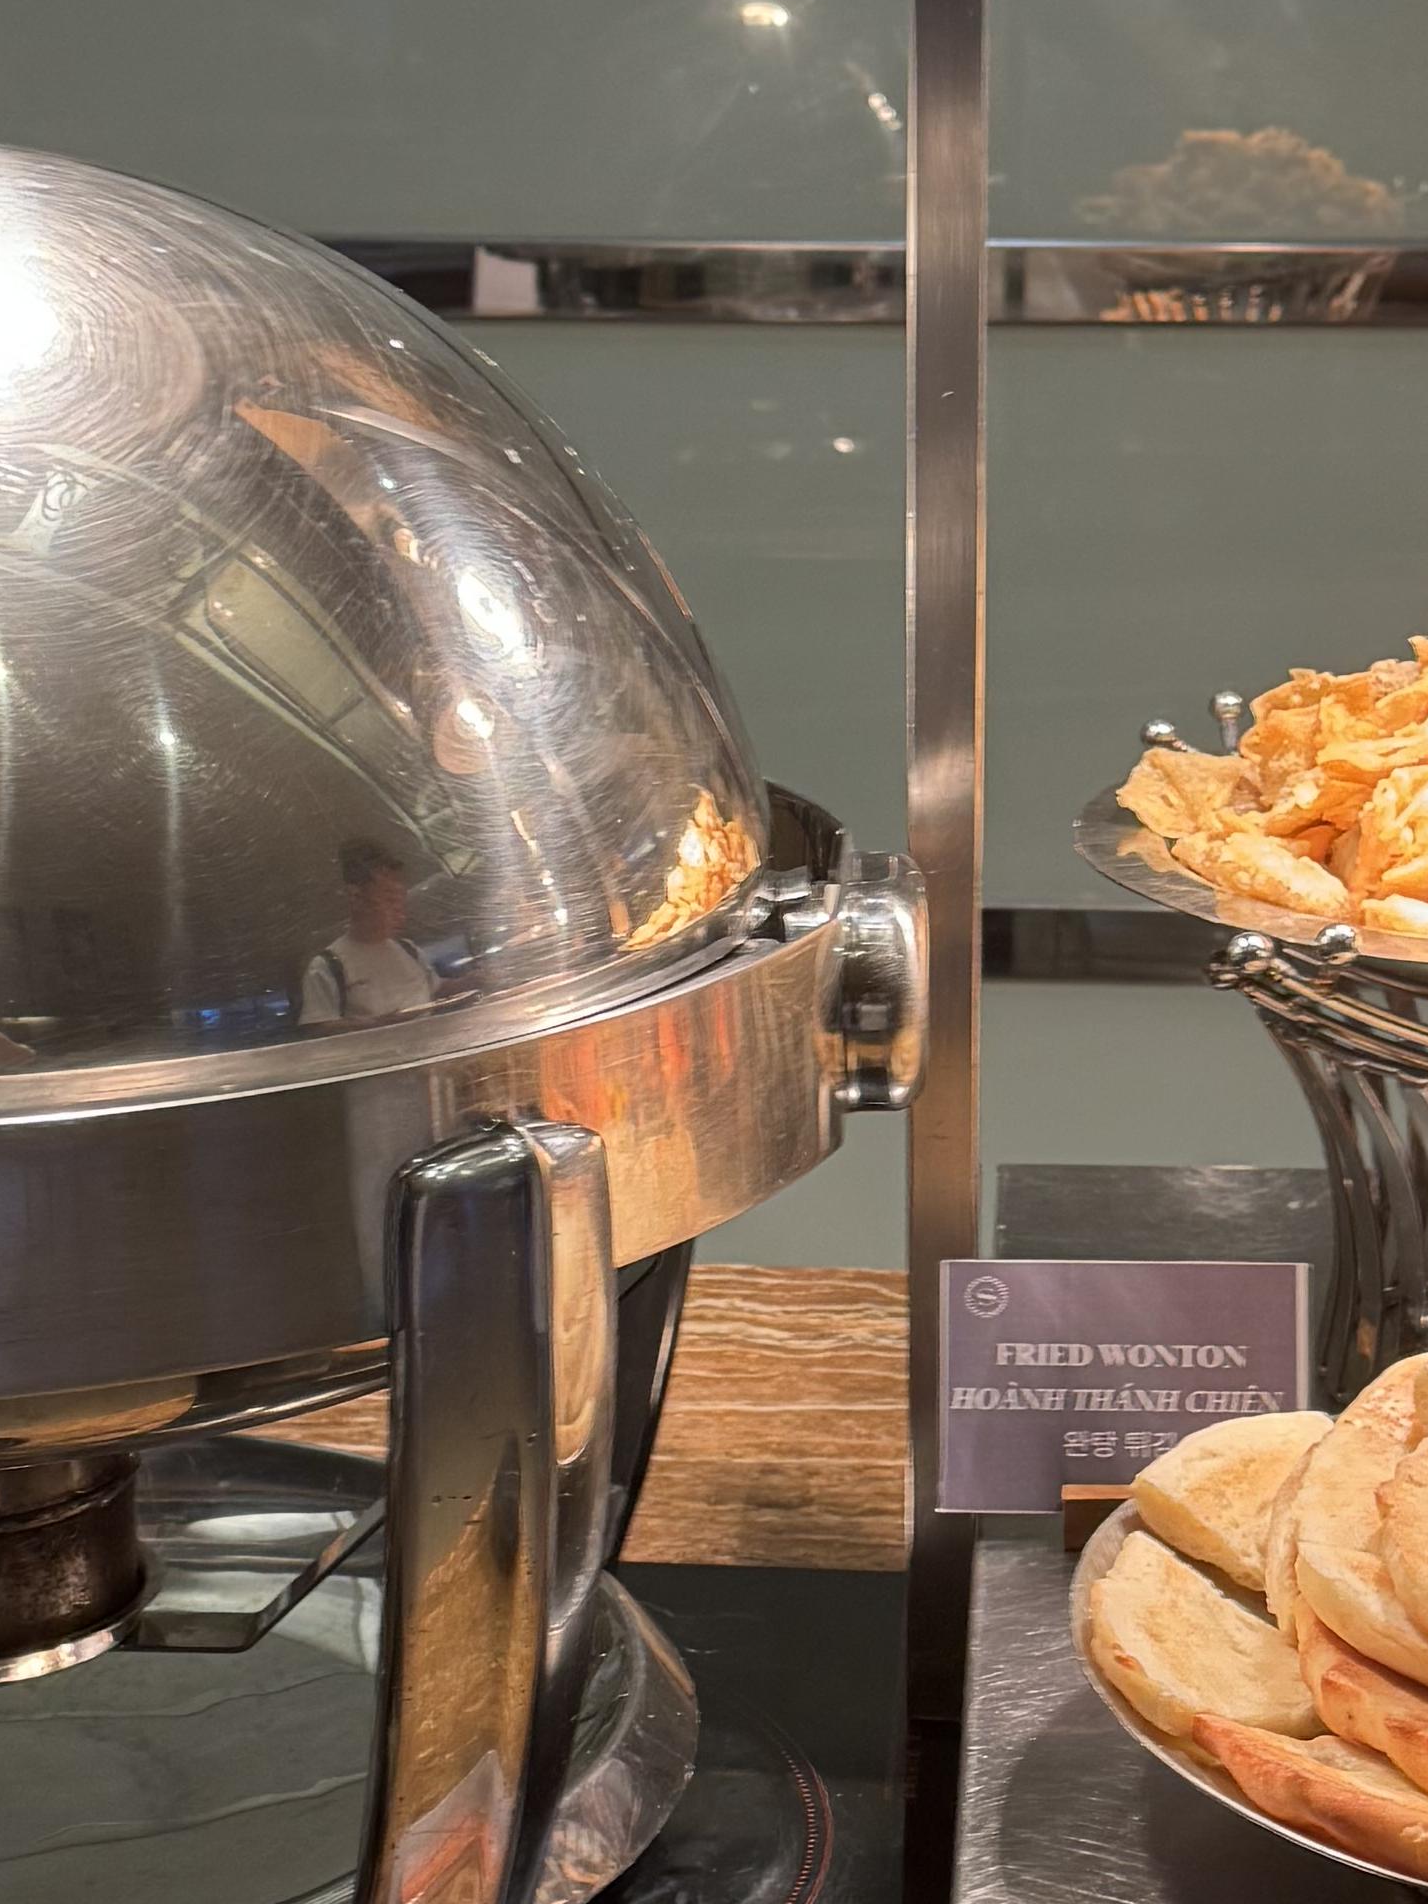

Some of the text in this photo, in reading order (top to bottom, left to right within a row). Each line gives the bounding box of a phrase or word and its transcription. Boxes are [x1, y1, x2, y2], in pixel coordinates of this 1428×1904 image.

[996, 1342, 1251, 1369] FRIED WONTON
[949, 1381, 1068, 1411] HOÀNH
[1072, 1382, 1181, 1412] THÁNH
[1062, 1430, 1119, 1458] 완탕
